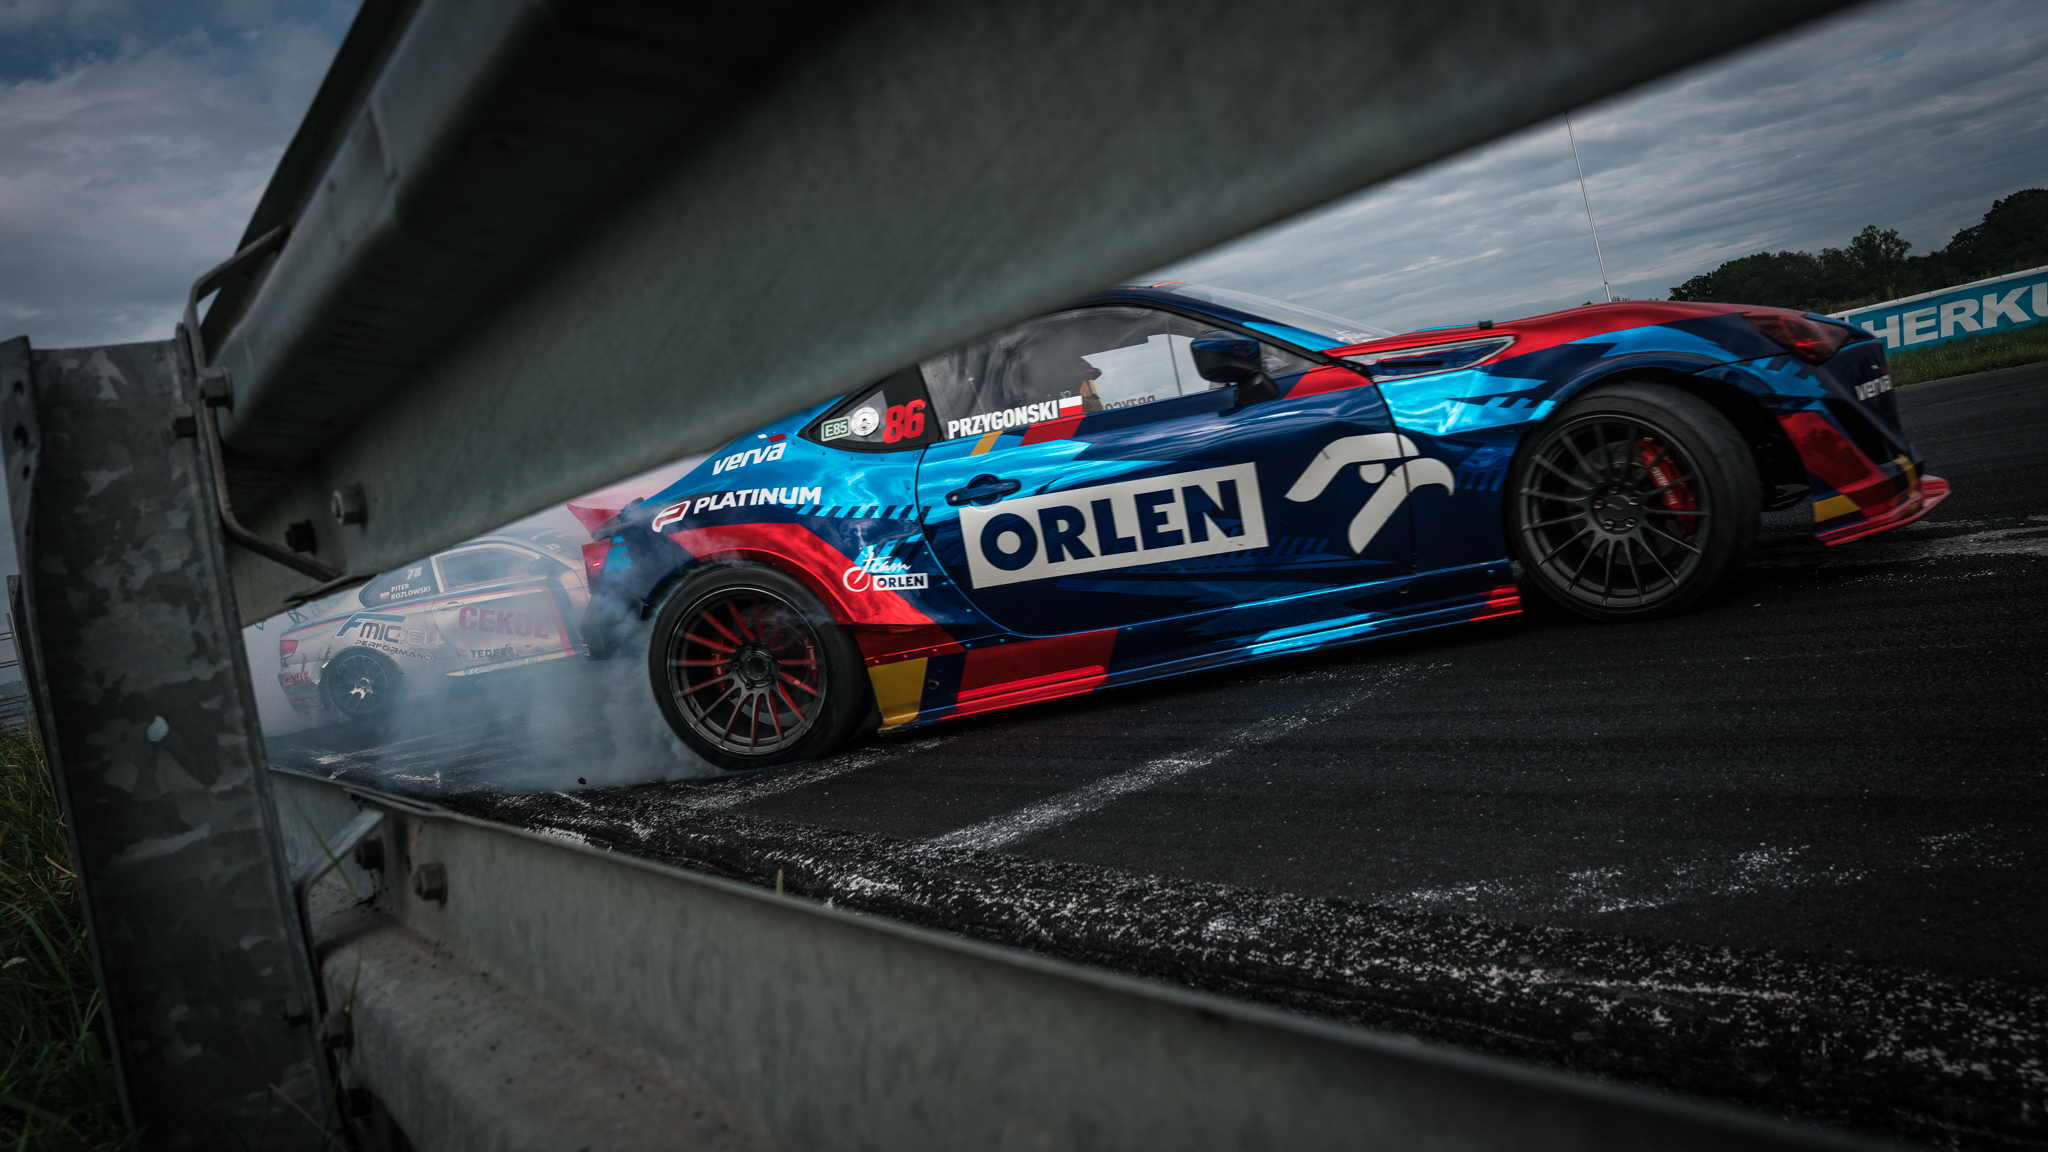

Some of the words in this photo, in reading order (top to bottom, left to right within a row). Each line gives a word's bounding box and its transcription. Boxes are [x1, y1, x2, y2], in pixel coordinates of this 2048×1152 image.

[825, 421, 848, 437] E85
[883, 398, 927, 444] 86
[947, 400, 1059, 439] PRZYGONSKI
[712, 442, 787, 476] verva
[693, 486, 822, 514] PLATINUM
[979, 478, 1246, 571] ORLEN
[405, 566, 423, 581] 78
[876, 574, 925, 588] ORLEN
[390, 583, 410, 593] PITER
[390, 586, 431, 600] KOZLOWSKI
[458, 606, 550, 639] CEKOL
